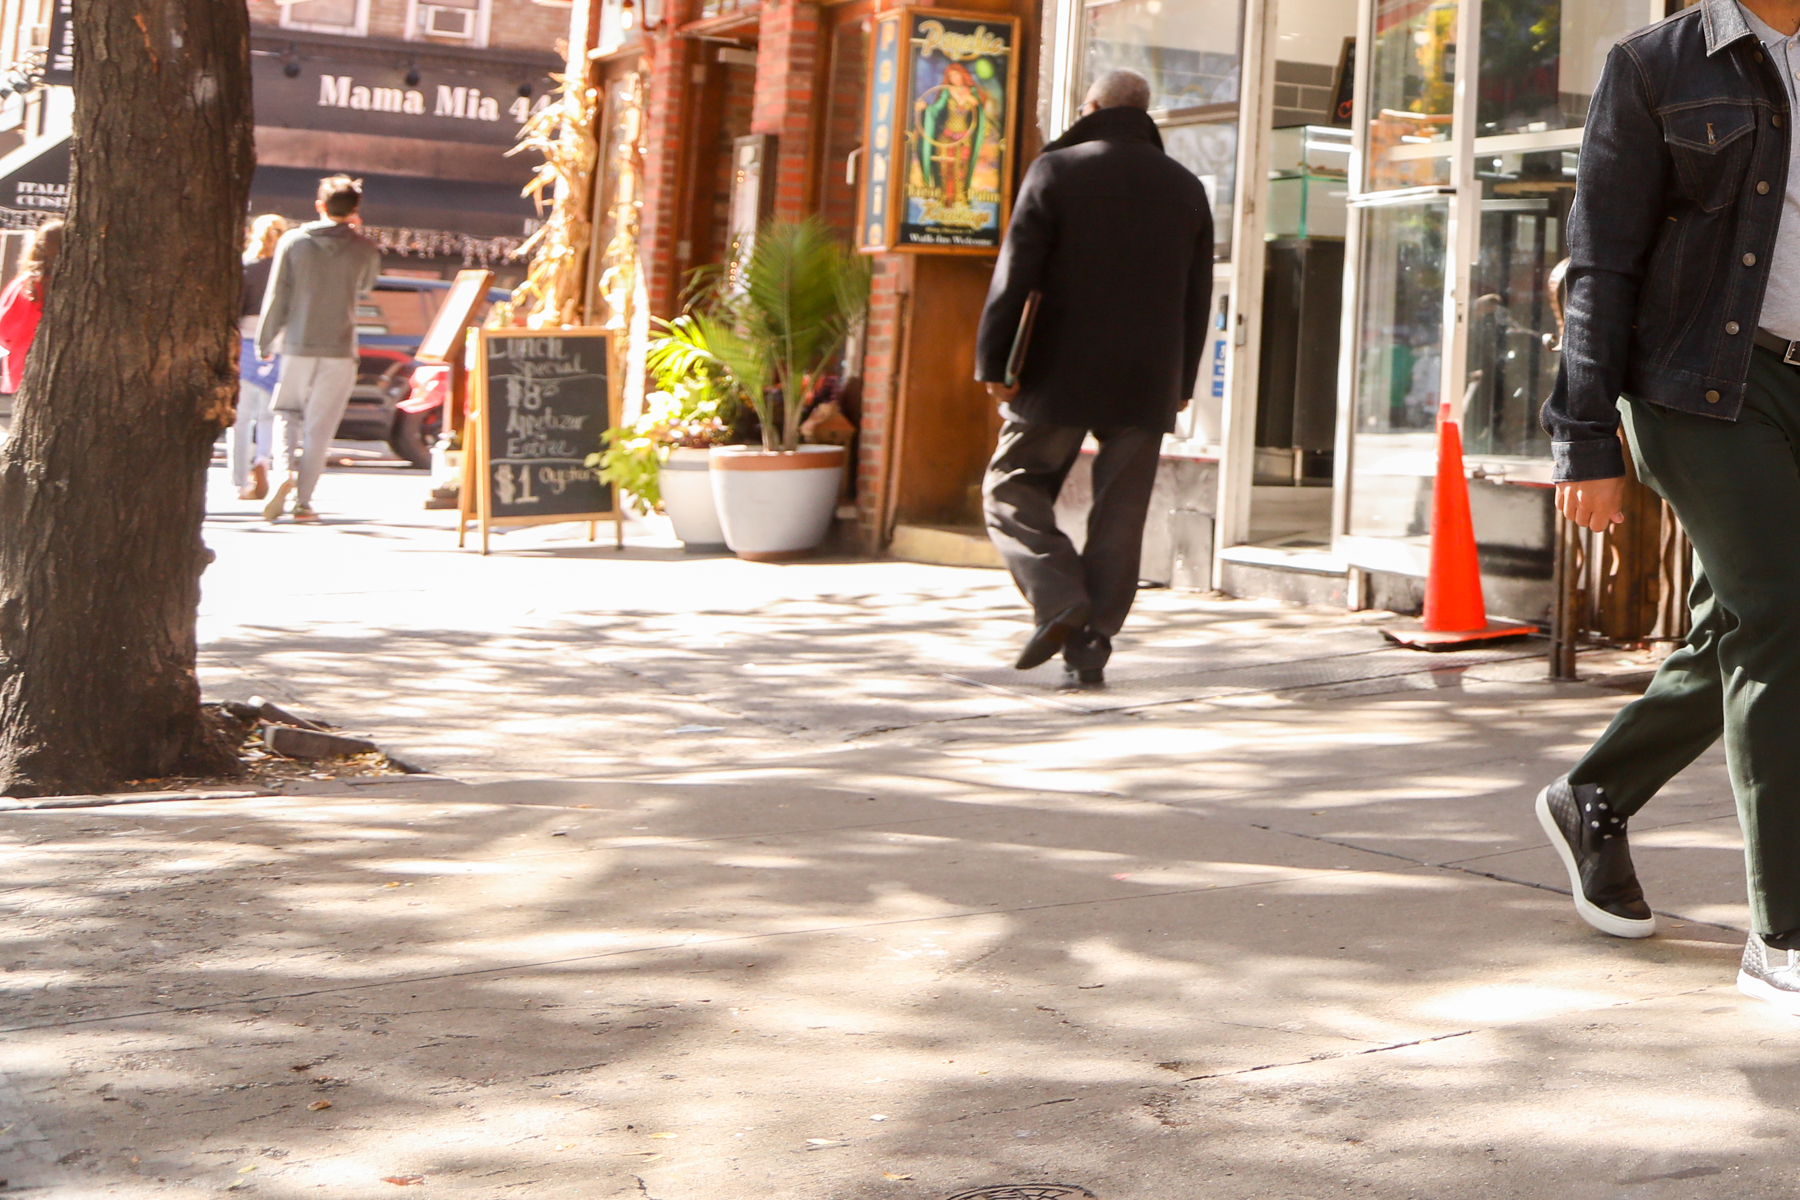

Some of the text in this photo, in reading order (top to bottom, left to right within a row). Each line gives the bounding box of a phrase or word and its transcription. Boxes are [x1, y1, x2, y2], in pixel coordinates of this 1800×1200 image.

[919, 19, 1005, 61] Psychic
[318, 74, 426, 116] Mama
[432, 84, 501, 122] Mia
[494, 463, 541, 505] $1
